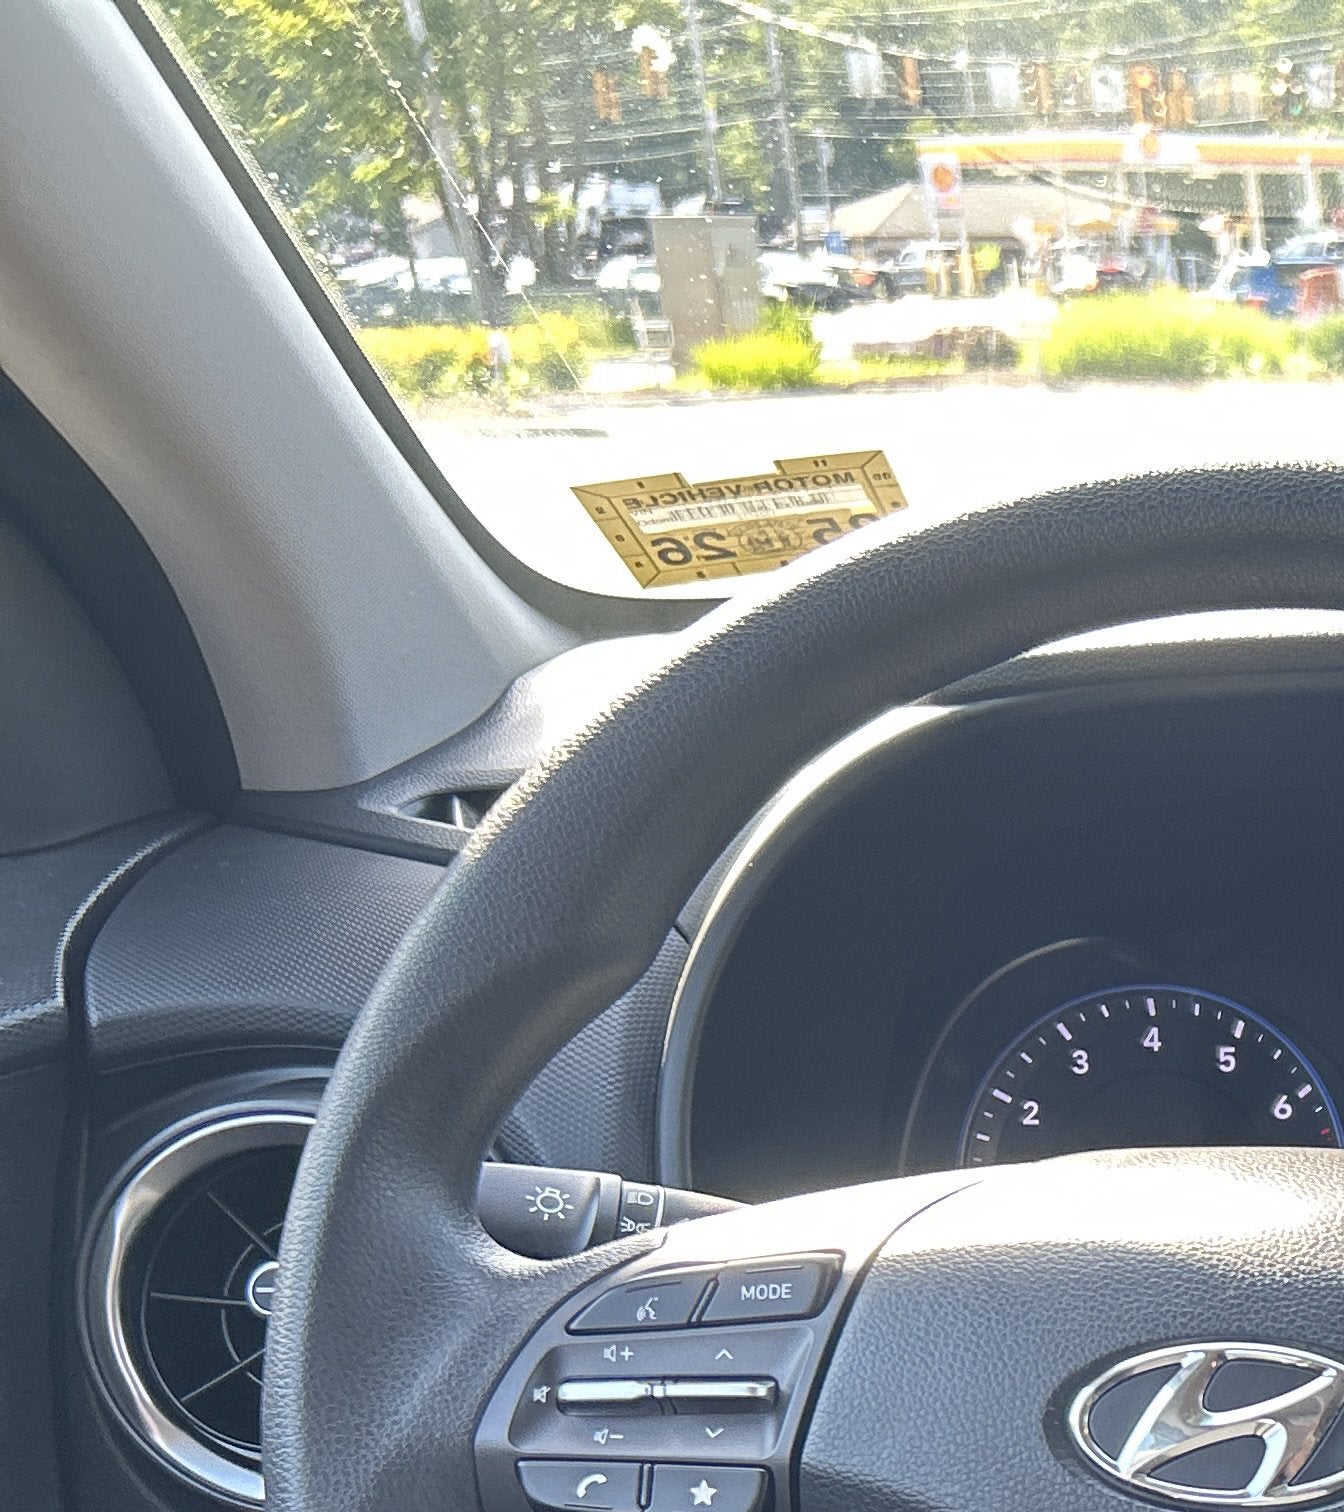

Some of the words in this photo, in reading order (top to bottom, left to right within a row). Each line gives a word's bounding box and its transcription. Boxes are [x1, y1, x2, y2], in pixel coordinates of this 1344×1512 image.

[1142, 1026, 1162, 1052] 4
[1071, 1049, 1090, 1076] 3
[1218, 1045, 1237, 1073] 5
[1021, 1100, 1040, 1126] 2
[1273, 1094, 1293, 1120] 6
[740, 1283, 793, 1301] MODE
